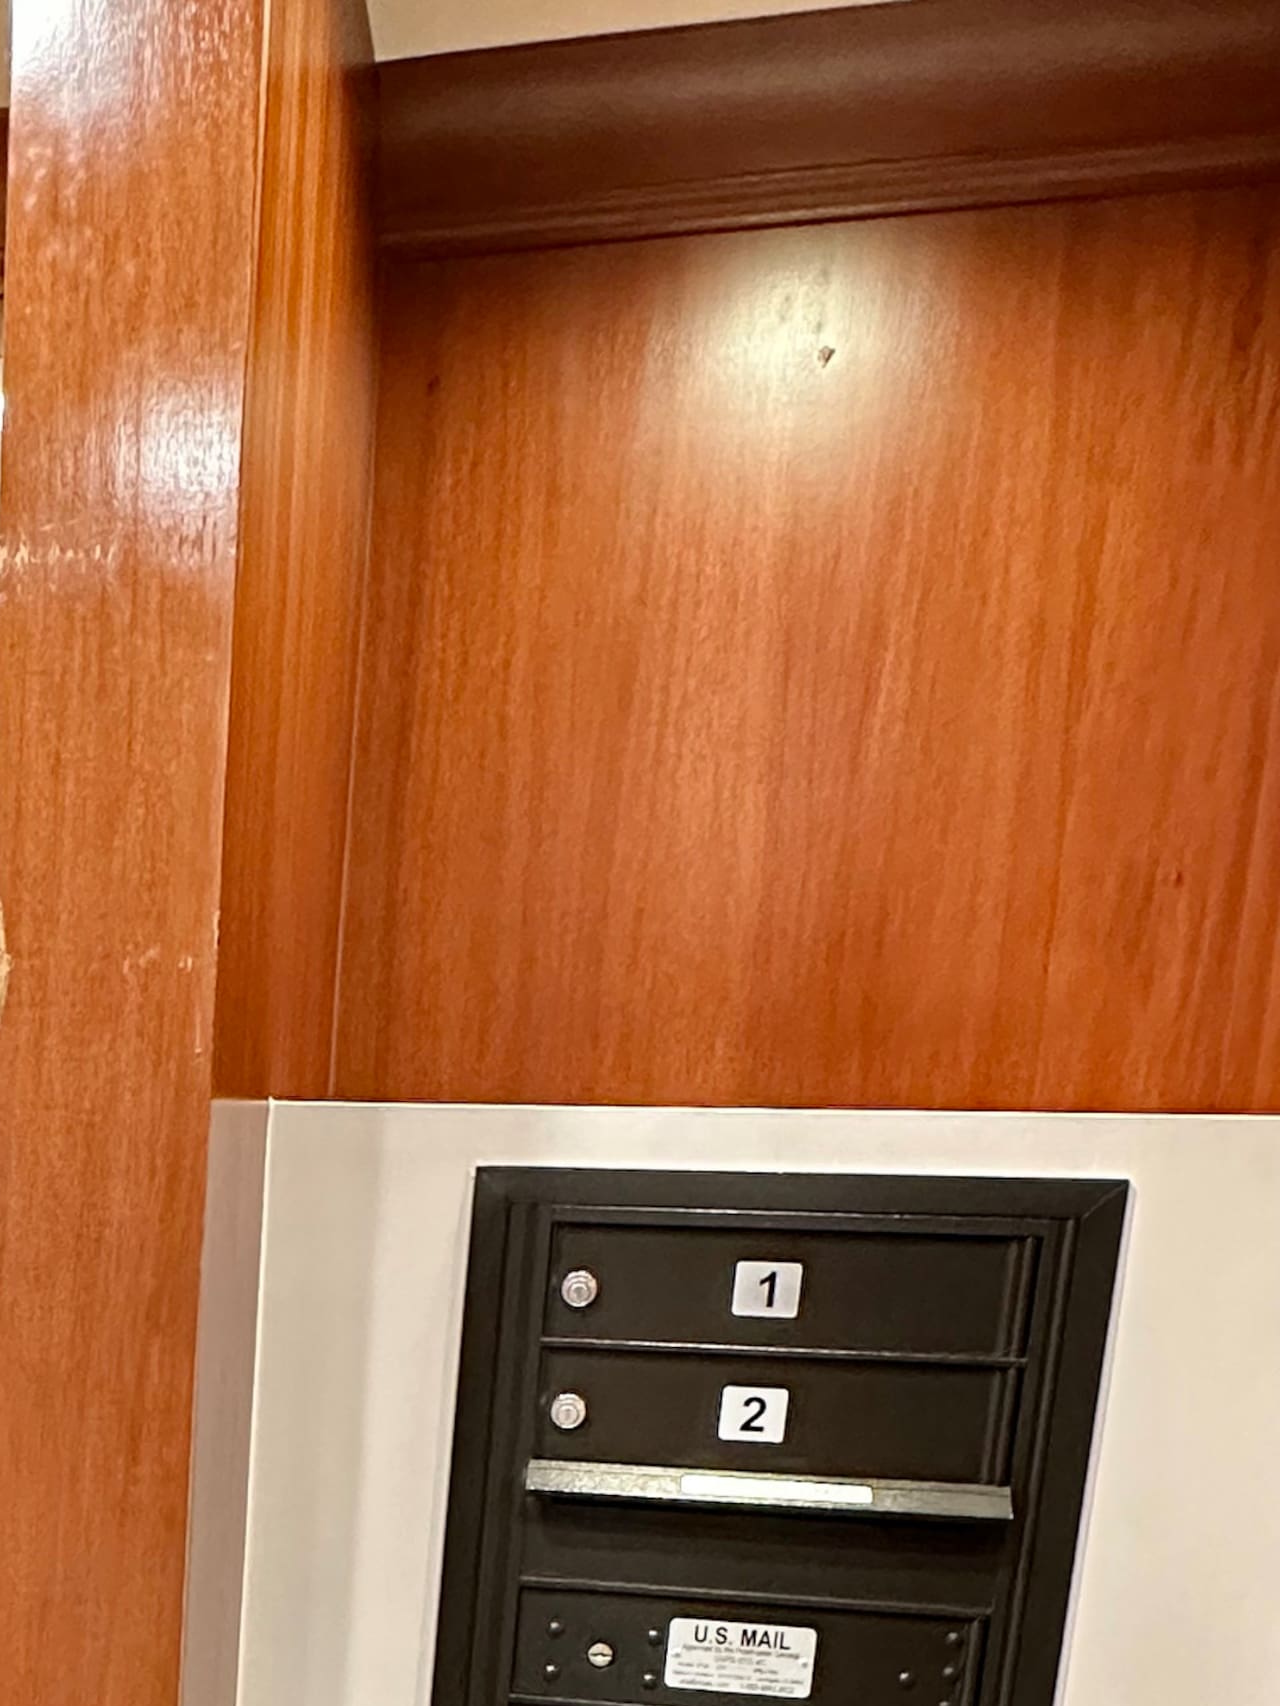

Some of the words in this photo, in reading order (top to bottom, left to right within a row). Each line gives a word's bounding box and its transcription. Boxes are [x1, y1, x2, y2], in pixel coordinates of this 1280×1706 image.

[759, 1271, 777, 1308] 1
[739, 1396, 767, 1433] 2
[694, 1624, 733, 1645] U.S.
[740, 1629, 791, 1650] MAIL
